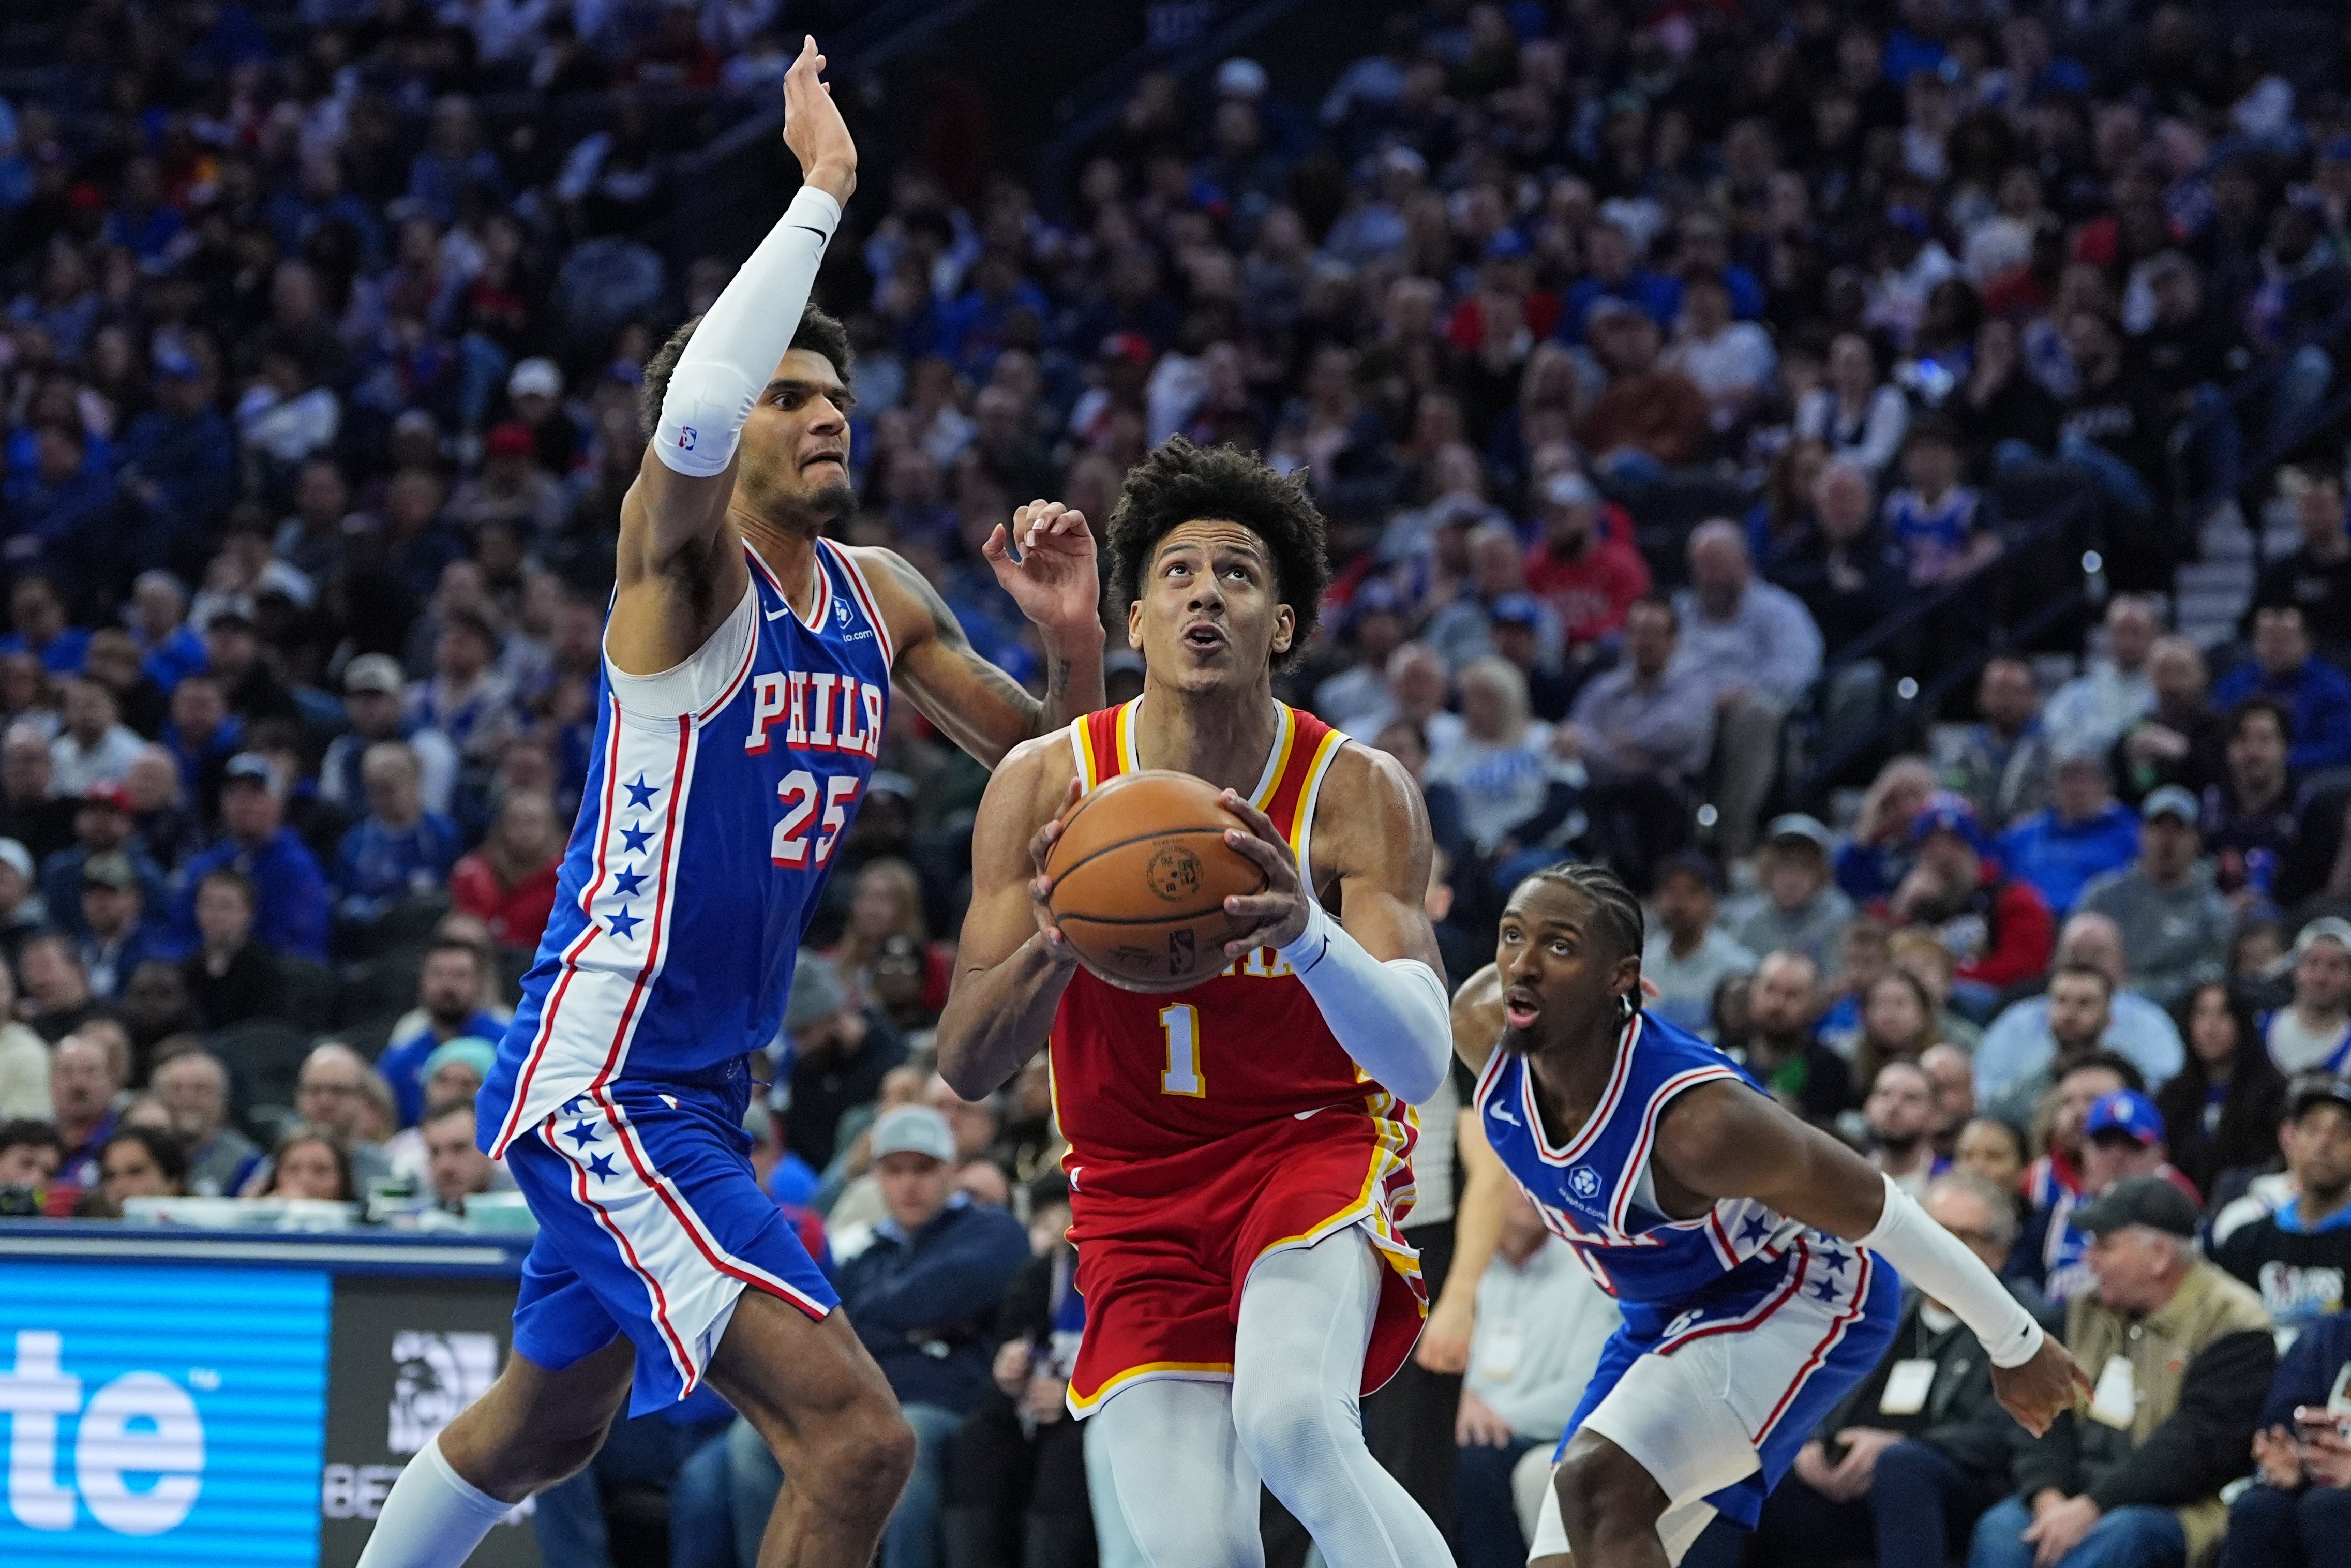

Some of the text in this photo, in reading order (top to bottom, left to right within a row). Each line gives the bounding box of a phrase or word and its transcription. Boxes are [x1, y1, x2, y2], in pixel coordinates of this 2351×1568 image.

[745, 671, 883, 761] PHILA
[771, 770, 860, 870] 25
[1159, 1002, 1205, 1099] 1
